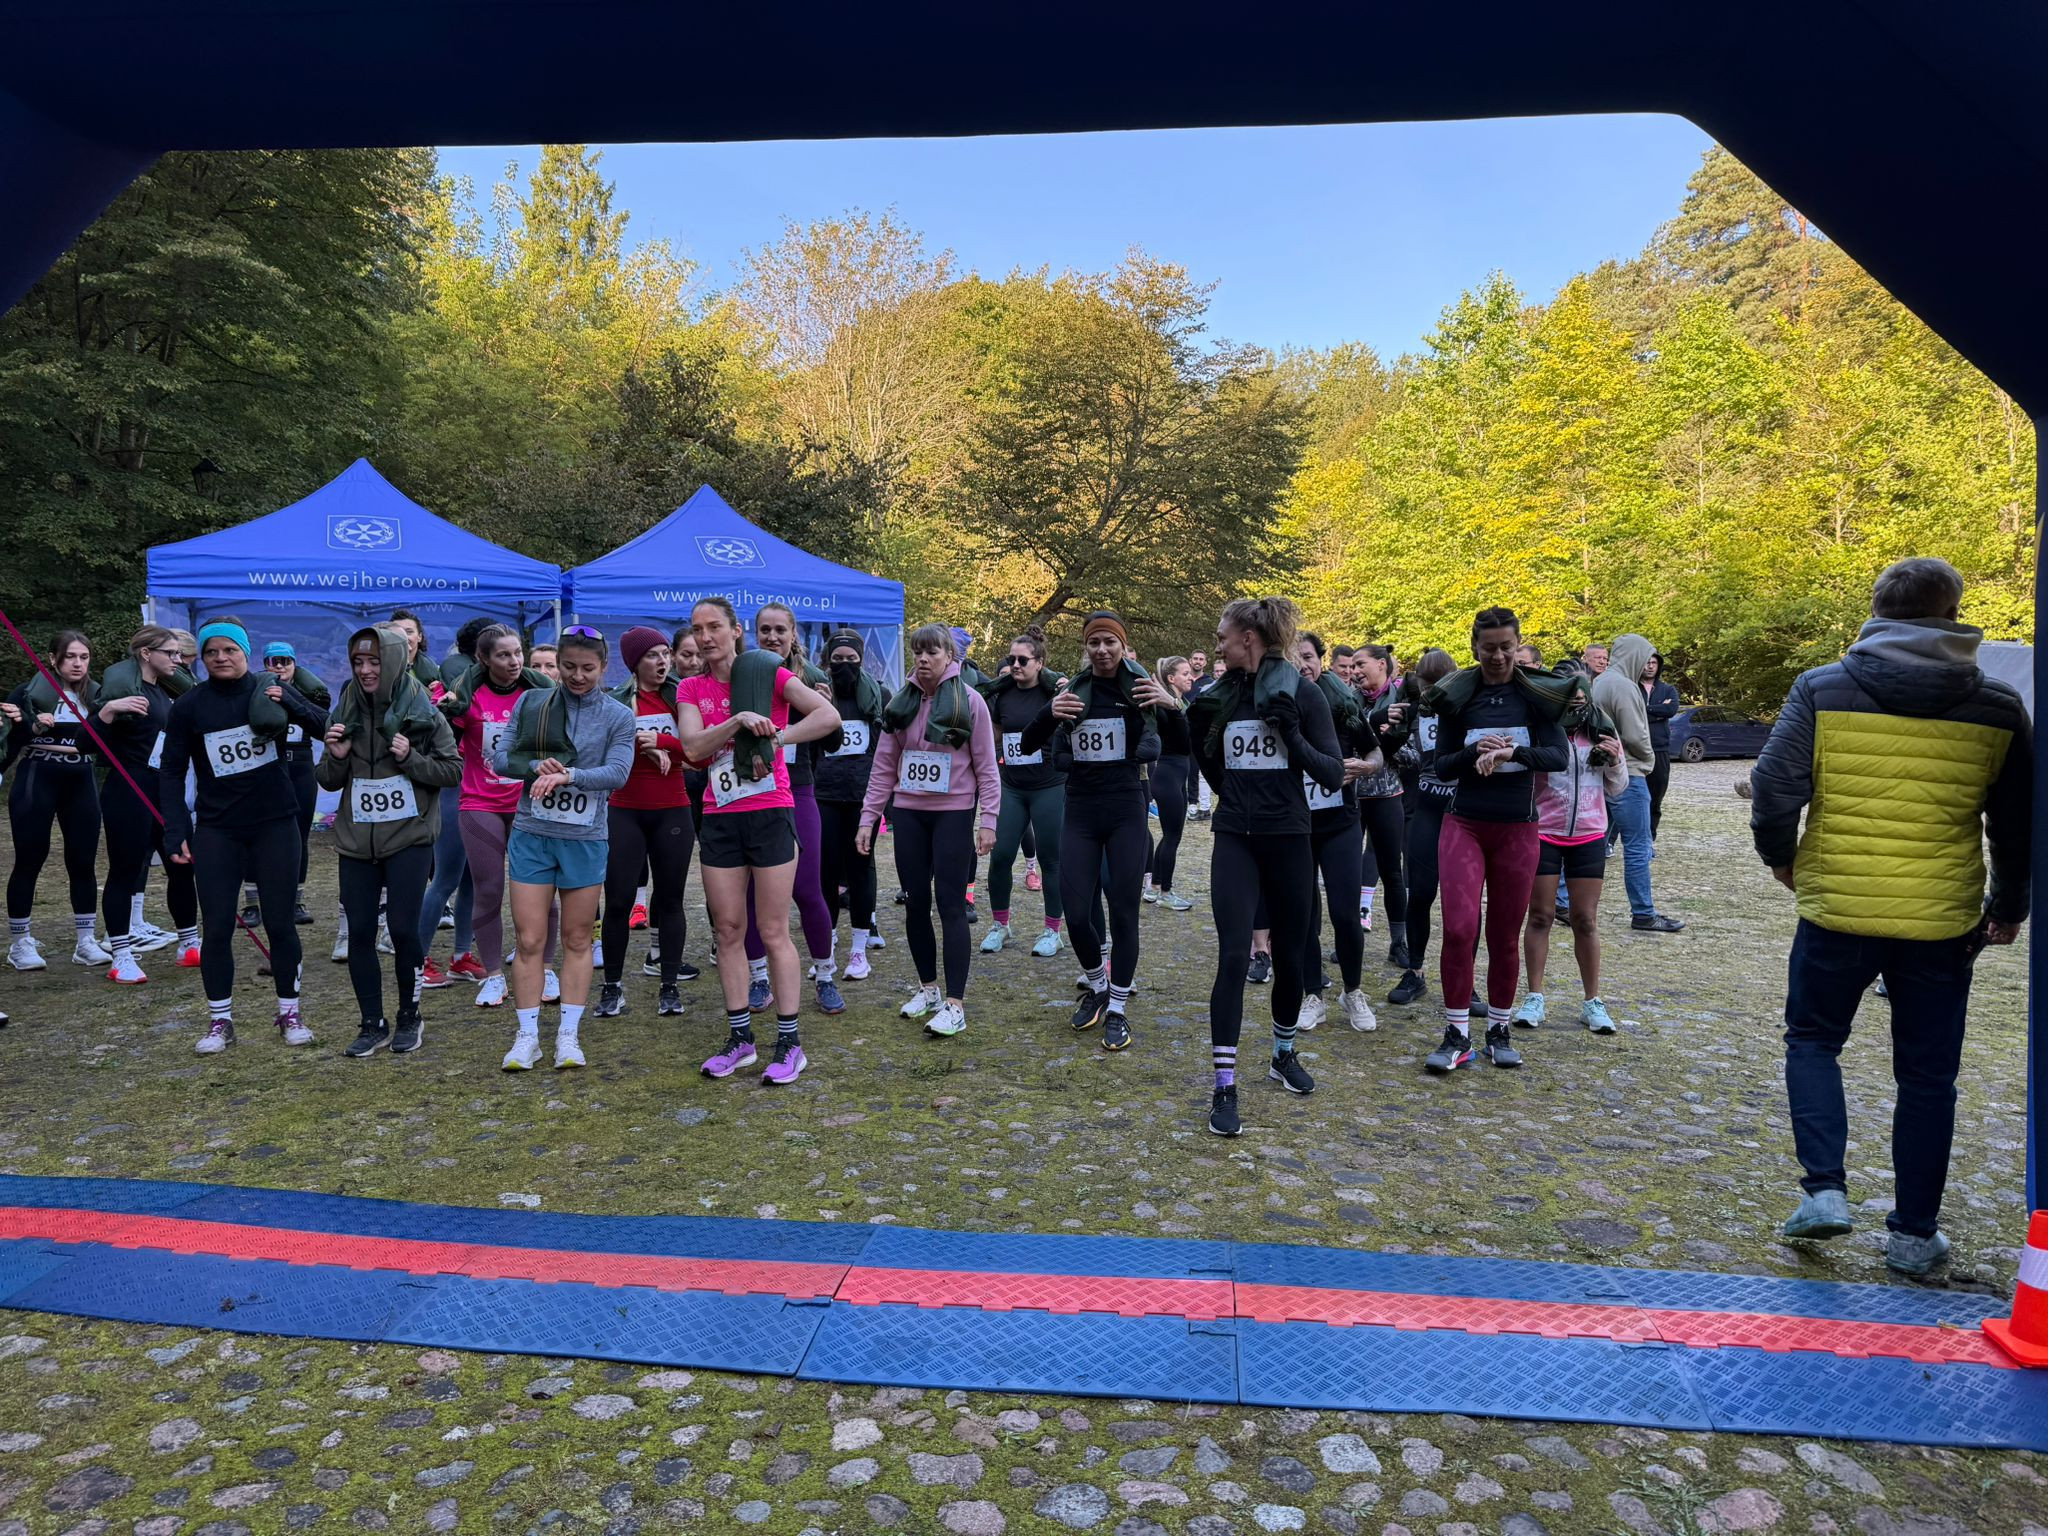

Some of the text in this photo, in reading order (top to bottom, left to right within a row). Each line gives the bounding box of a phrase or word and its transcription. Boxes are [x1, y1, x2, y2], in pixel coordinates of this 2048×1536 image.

[248, 571, 478, 592] www.wejherowo.pl
[653, 589, 837, 610] wwwejherowo.pl
[842, 730, 863, 747] 63
[1078, 731, 1115, 751] 881
[1232, 735, 1277, 758] 948
[1007, 743, 1023, 758] 89
[908, 763, 941, 783] 899
[1430, 782, 1456, 797] NIK
[360, 790, 405, 813] 898
[541, 790, 588, 815] 880
